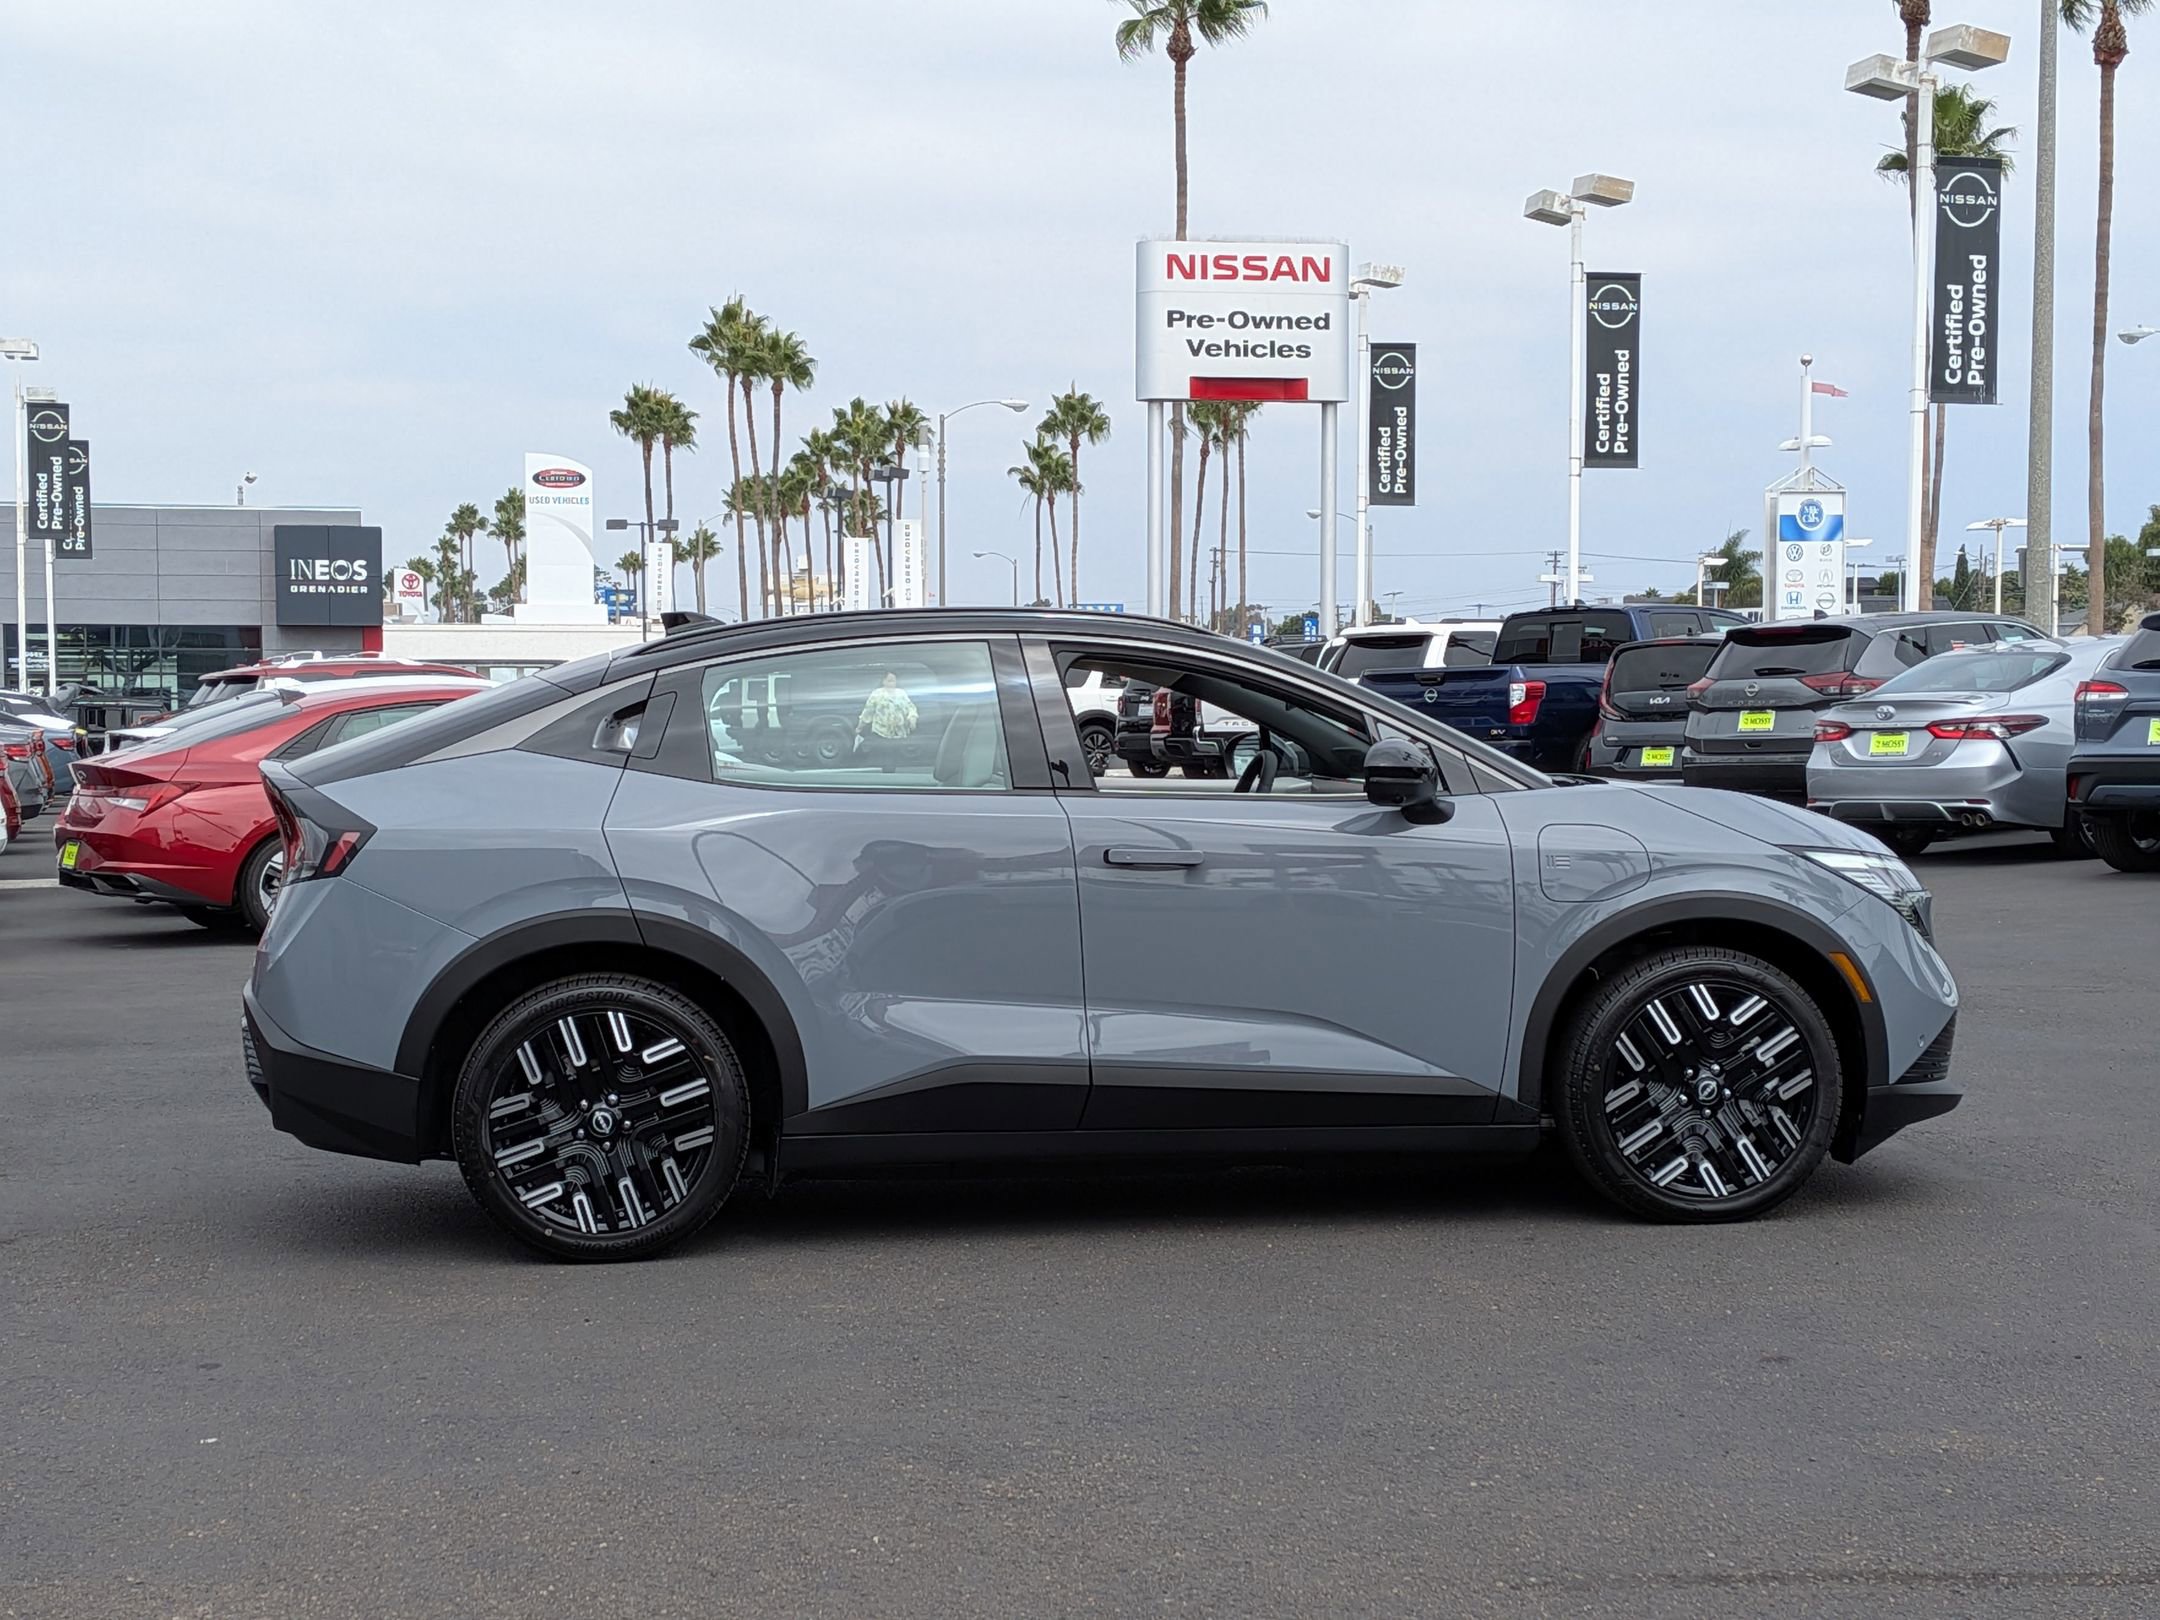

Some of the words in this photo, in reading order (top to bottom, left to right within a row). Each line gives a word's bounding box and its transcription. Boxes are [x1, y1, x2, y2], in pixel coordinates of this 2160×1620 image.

[1939, 193, 1998, 206] NISSAN
[1166, 253, 1331, 282] NISSAN
[1167, 309, 1331, 330] Pre-Owned
[1588, 302, 1638, 311] NISSAN
[1967, 254, 1987, 386] Pre-Owned
[1186, 338, 1312, 359] Vehicles
[1945, 283, 1964, 385] Certified
[1372, 367, 1414, 375] NISSAN
[1595, 373, 1611, 453] Certified
[1614, 349, 1630, 453] Pre-Owned
[1377, 426, 1391, 493] Certified
[1394, 406, 1407, 494] Pre-Owned
[36, 472, 48, 529] Certified
[50, 456, 63, 530] Pre-Owned
[528, 496, 551, 504] USED
[552, 496, 590, 505] VEHICLES
[73, 486, 85, 551] Pre-Owned
[289, 558, 368, 581] INEOS
[290, 585, 368, 593] GRENADIER
[398, 590, 423, 598] TOYOTA
